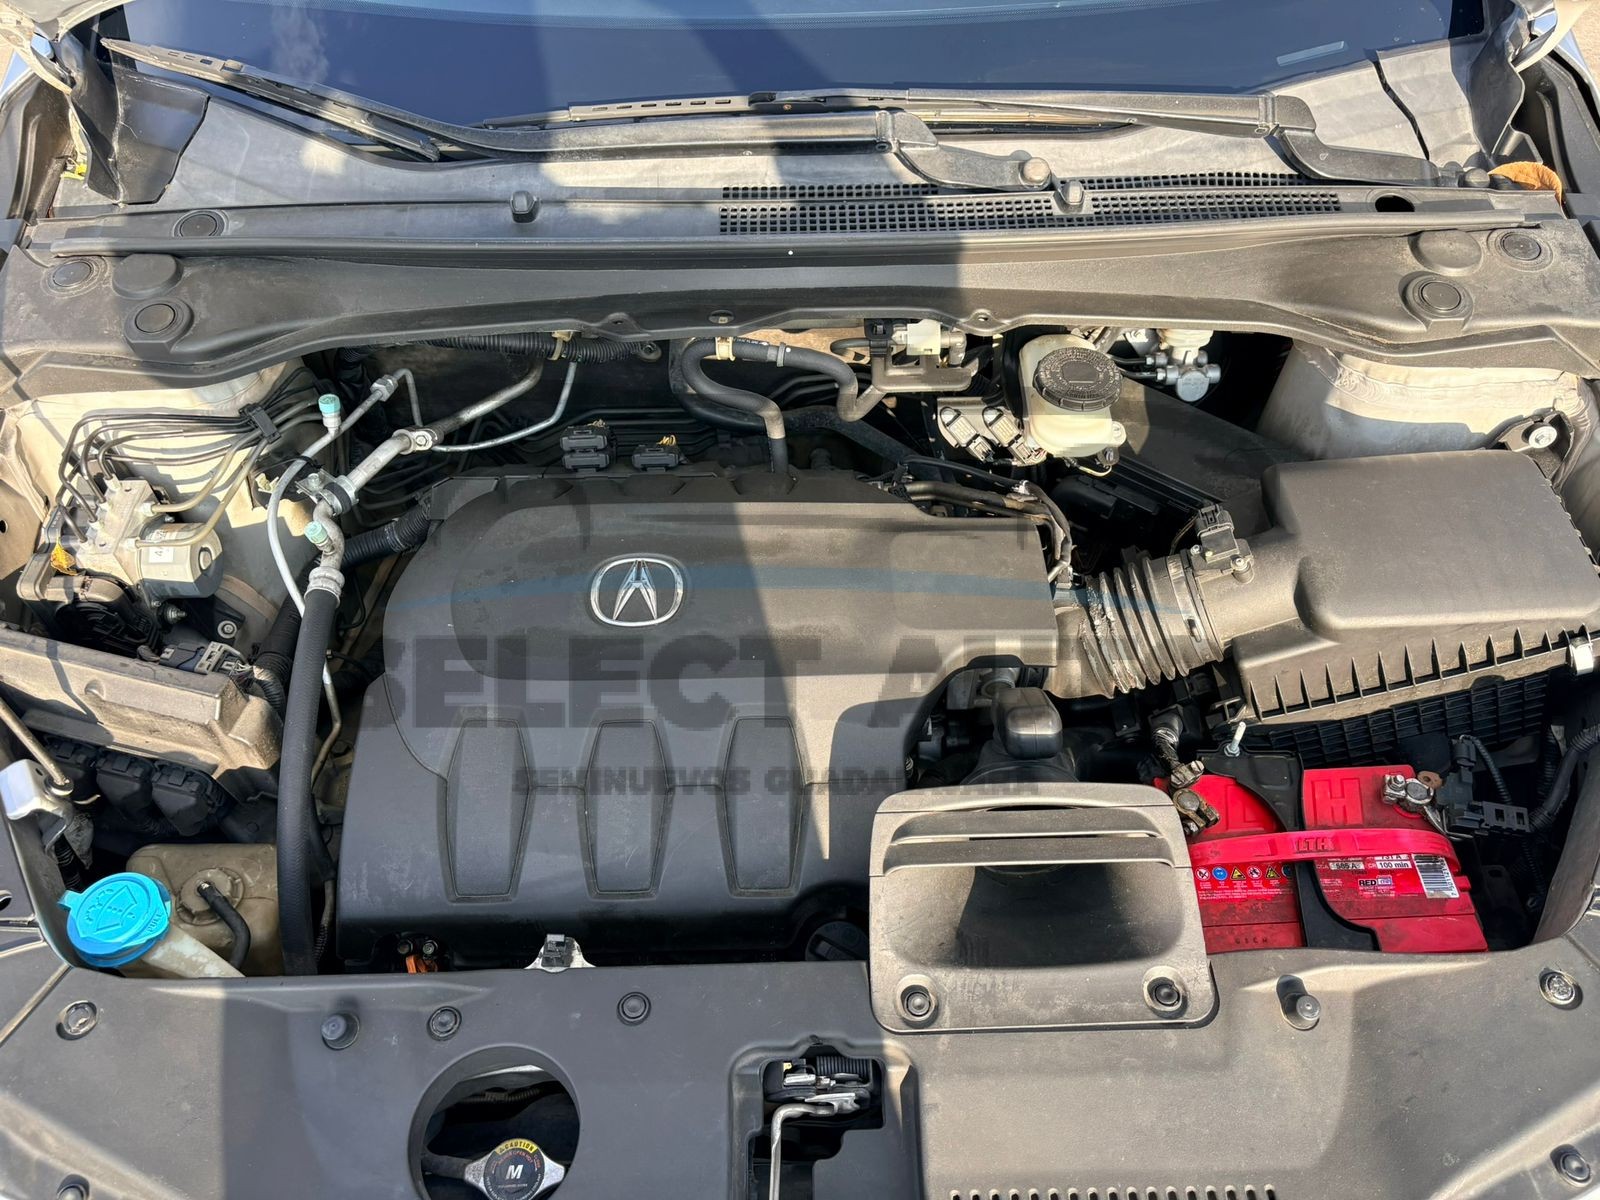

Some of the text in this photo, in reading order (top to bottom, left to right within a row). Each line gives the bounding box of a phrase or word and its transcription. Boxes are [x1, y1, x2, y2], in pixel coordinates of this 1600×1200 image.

[1297, 836, 1335, 852] LTH
[1379, 861, 1393, 869] 100
[1358, 879, 1377, 887] RED
[504, 1140, 535, 1152] CAUTION
[505, 1164, 524, 1180] M
